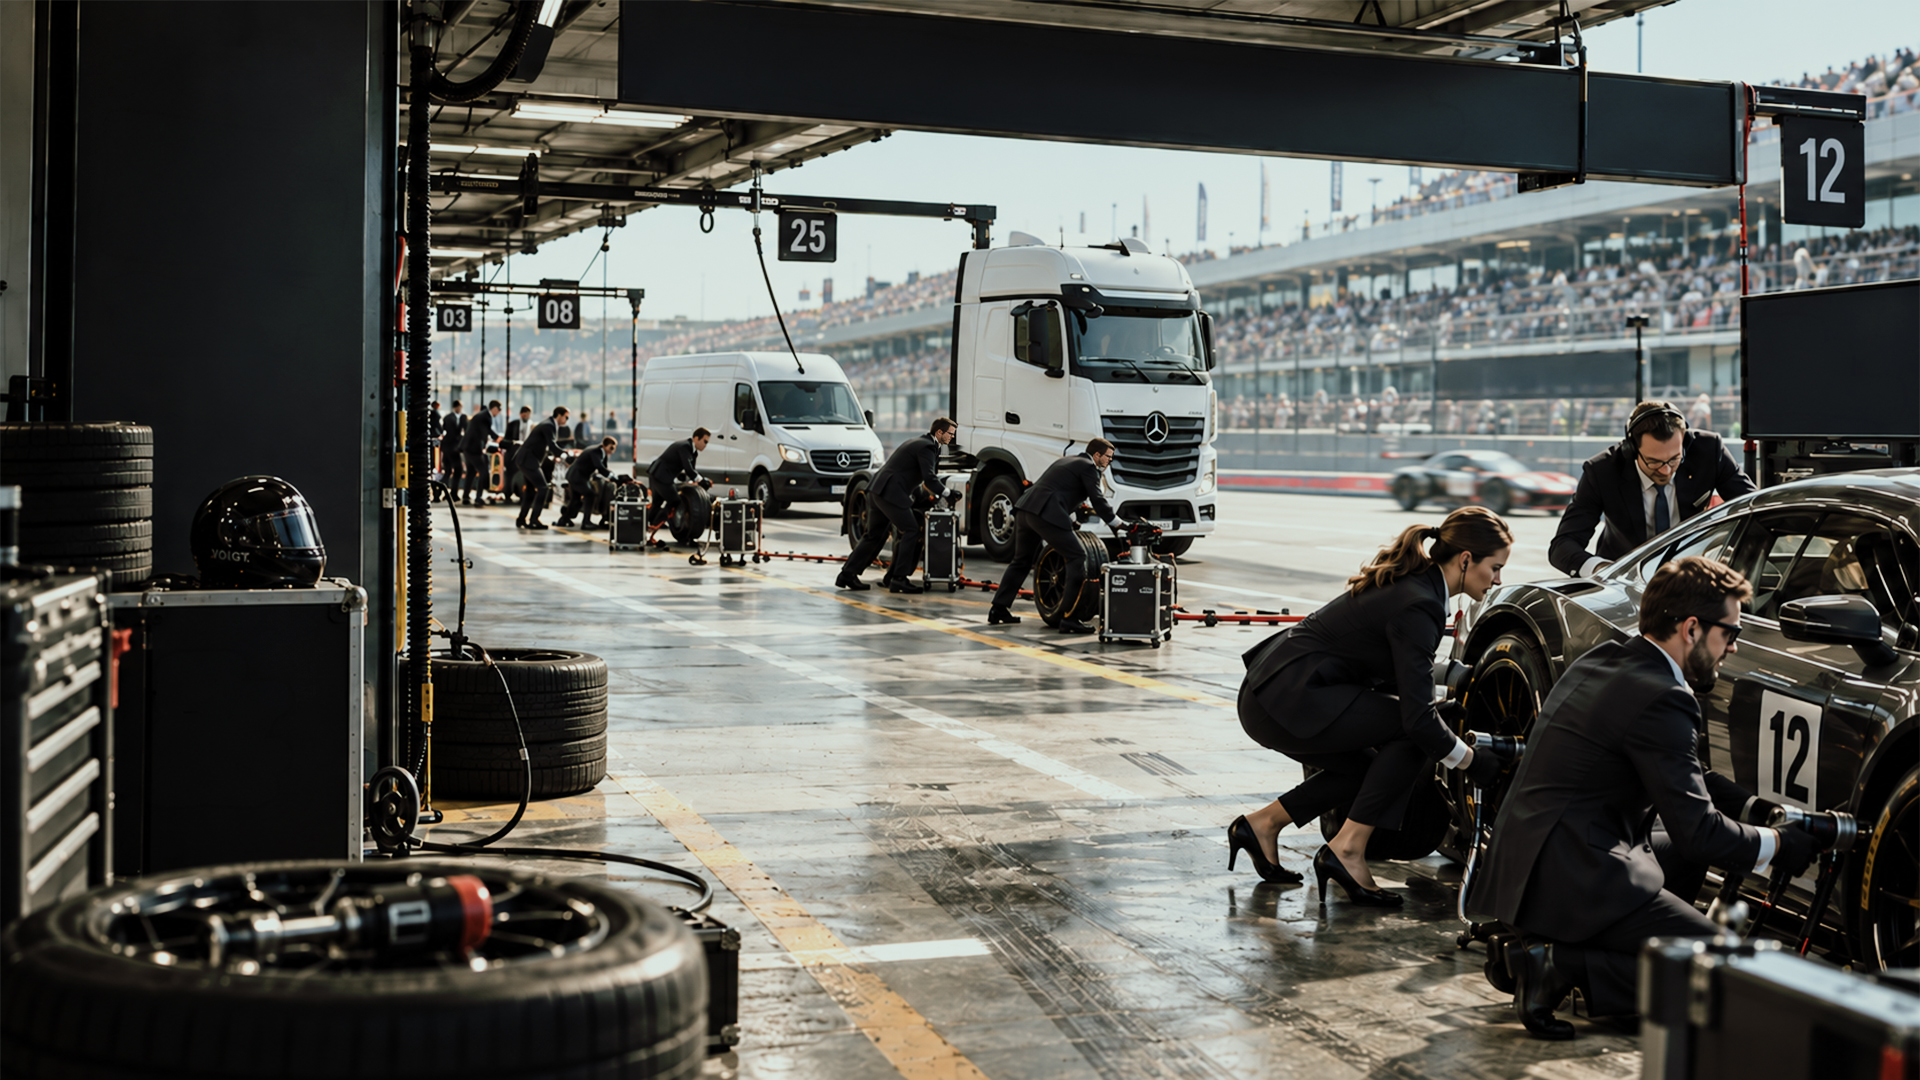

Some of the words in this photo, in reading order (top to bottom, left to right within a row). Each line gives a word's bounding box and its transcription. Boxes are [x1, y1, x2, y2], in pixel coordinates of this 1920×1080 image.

[1799, 138, 1845, 203] 12
[790, 218, 826, 253] 25
[442, 308, 467, 328] 03
[545, 299, 574, 324] 08
[1769, 710, 1810, 804] 12
